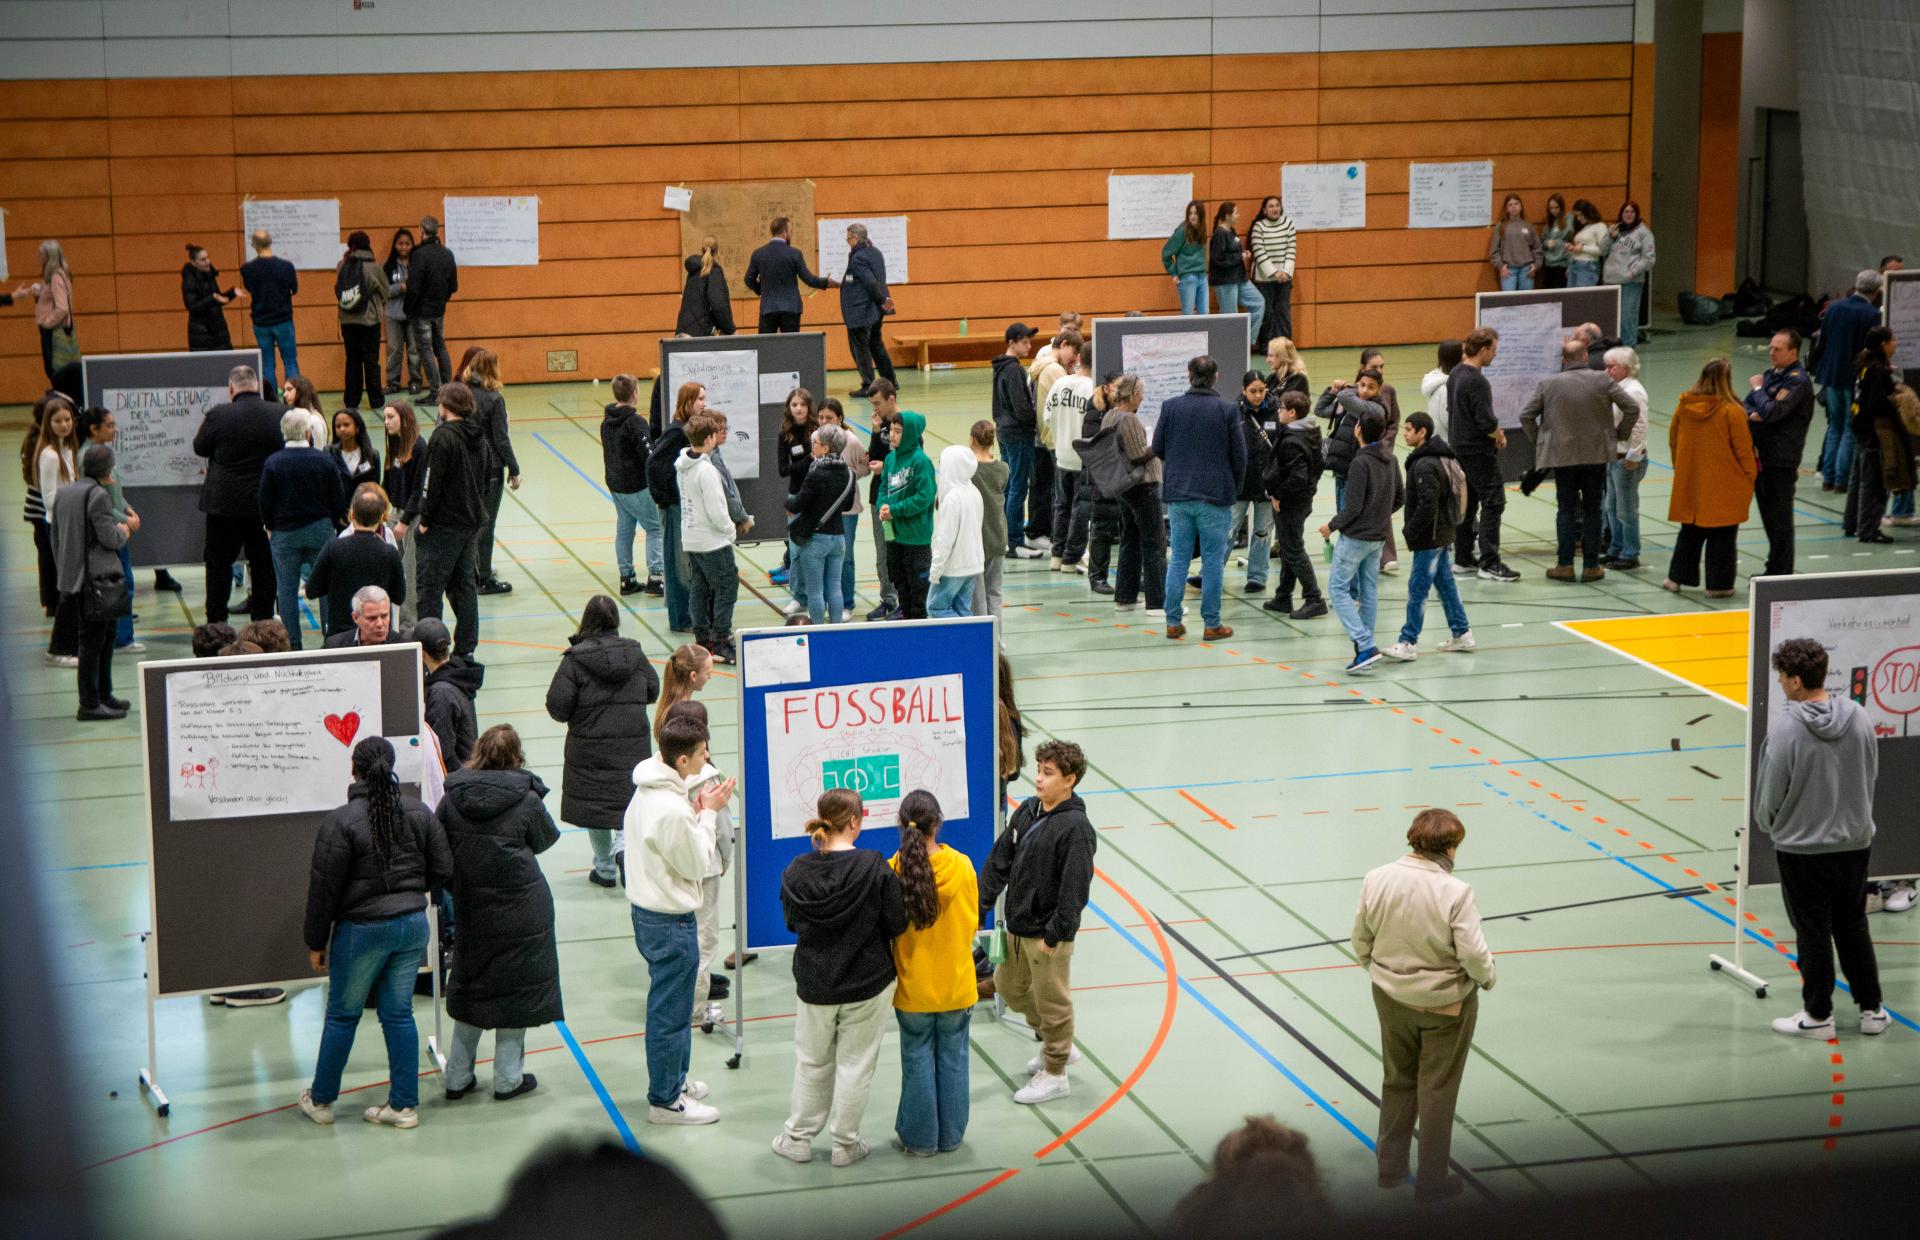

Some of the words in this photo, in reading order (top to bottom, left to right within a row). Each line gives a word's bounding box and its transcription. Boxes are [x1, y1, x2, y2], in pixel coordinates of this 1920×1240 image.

[116, 389, 211, 410] DIGITALISIERUNG
[131, 409, 151, 420] DER
[159, 408, 190, 418] SCHULEN
[203, 672, 249, 686] Bildung
[254, 671, 269, 680] und
[783, 685, 962, 734] FUSSBALL
